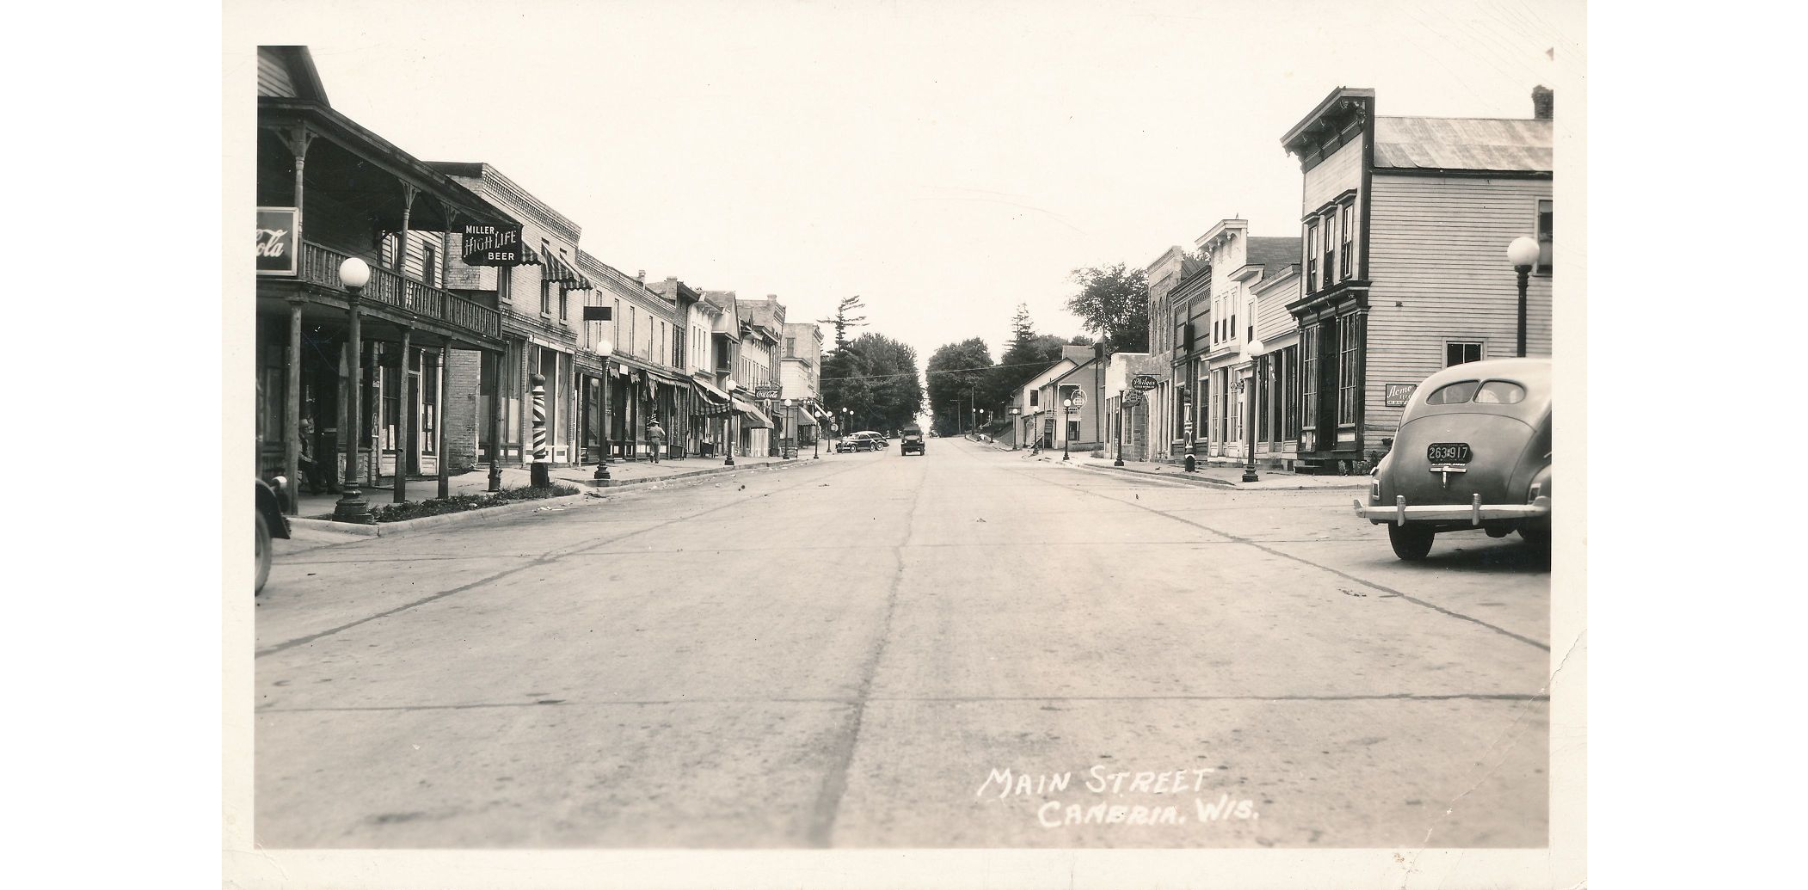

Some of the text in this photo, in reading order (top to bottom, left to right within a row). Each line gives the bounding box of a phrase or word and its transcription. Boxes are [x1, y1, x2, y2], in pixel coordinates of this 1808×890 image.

[465, 225, 495, 235] MILLER
[463, 230, 517, 258] HIGH LIFE
[488, 252, 515, 261] BEER
